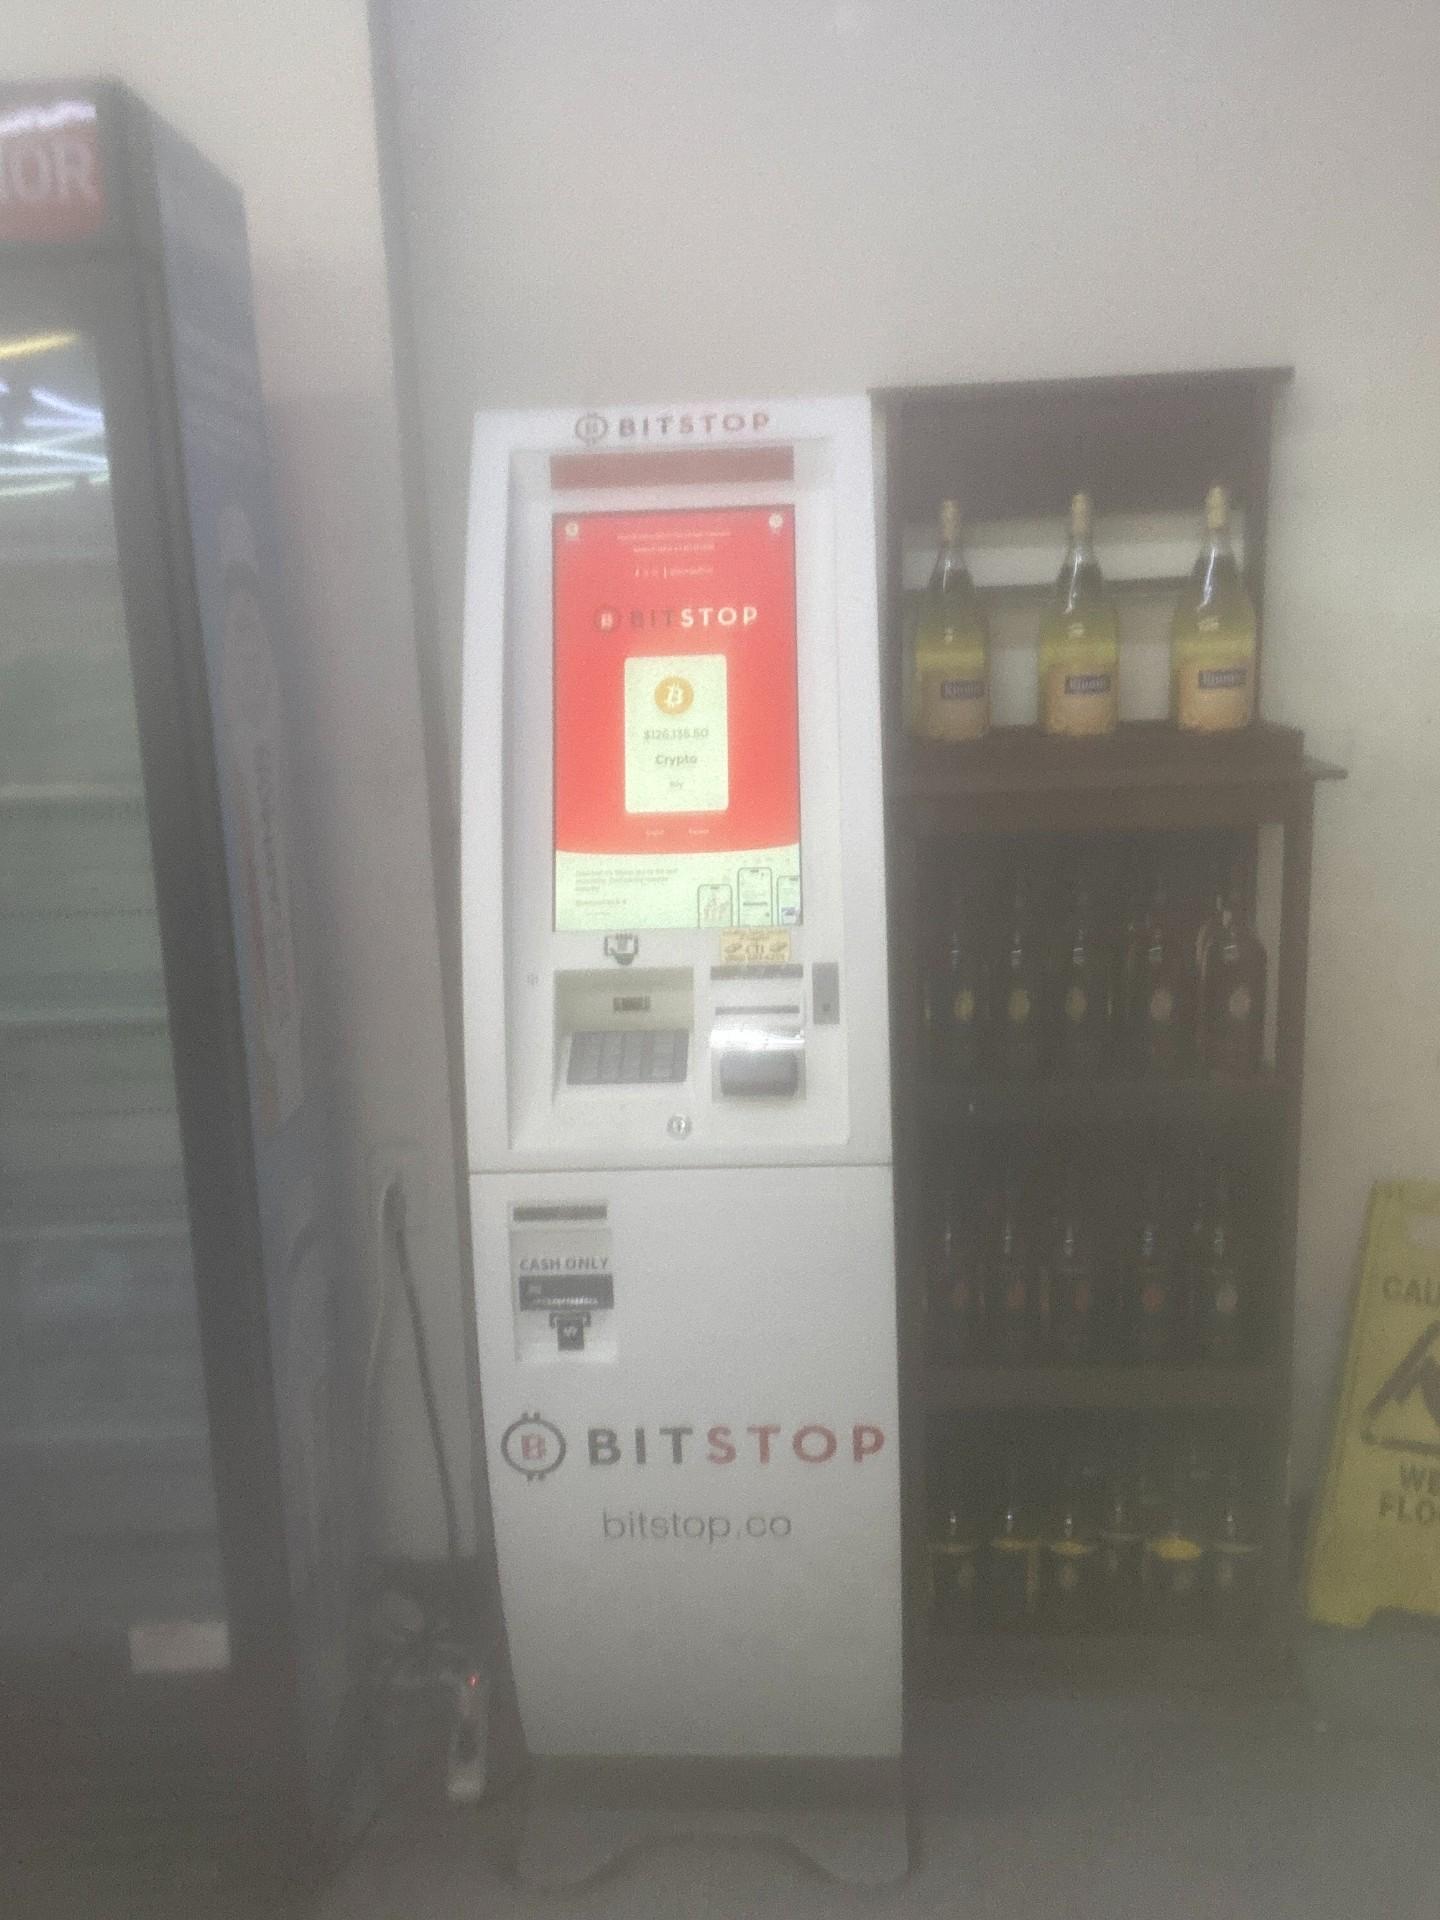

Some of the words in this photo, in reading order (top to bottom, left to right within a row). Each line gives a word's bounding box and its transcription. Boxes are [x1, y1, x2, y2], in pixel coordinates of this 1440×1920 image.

[618, 413, 769, 437] BITSTOP
[630, 607, 758, 629] BITSTOP
[654, 753, 699, 768] Crypto
[518, 1257, 561, 1272] CASH
[564, 1256, 609, 1271] ONLY
[587, 1424, 885, 1466] BITSTOP
[602, 1510, 793, 1545] bitstop.co
